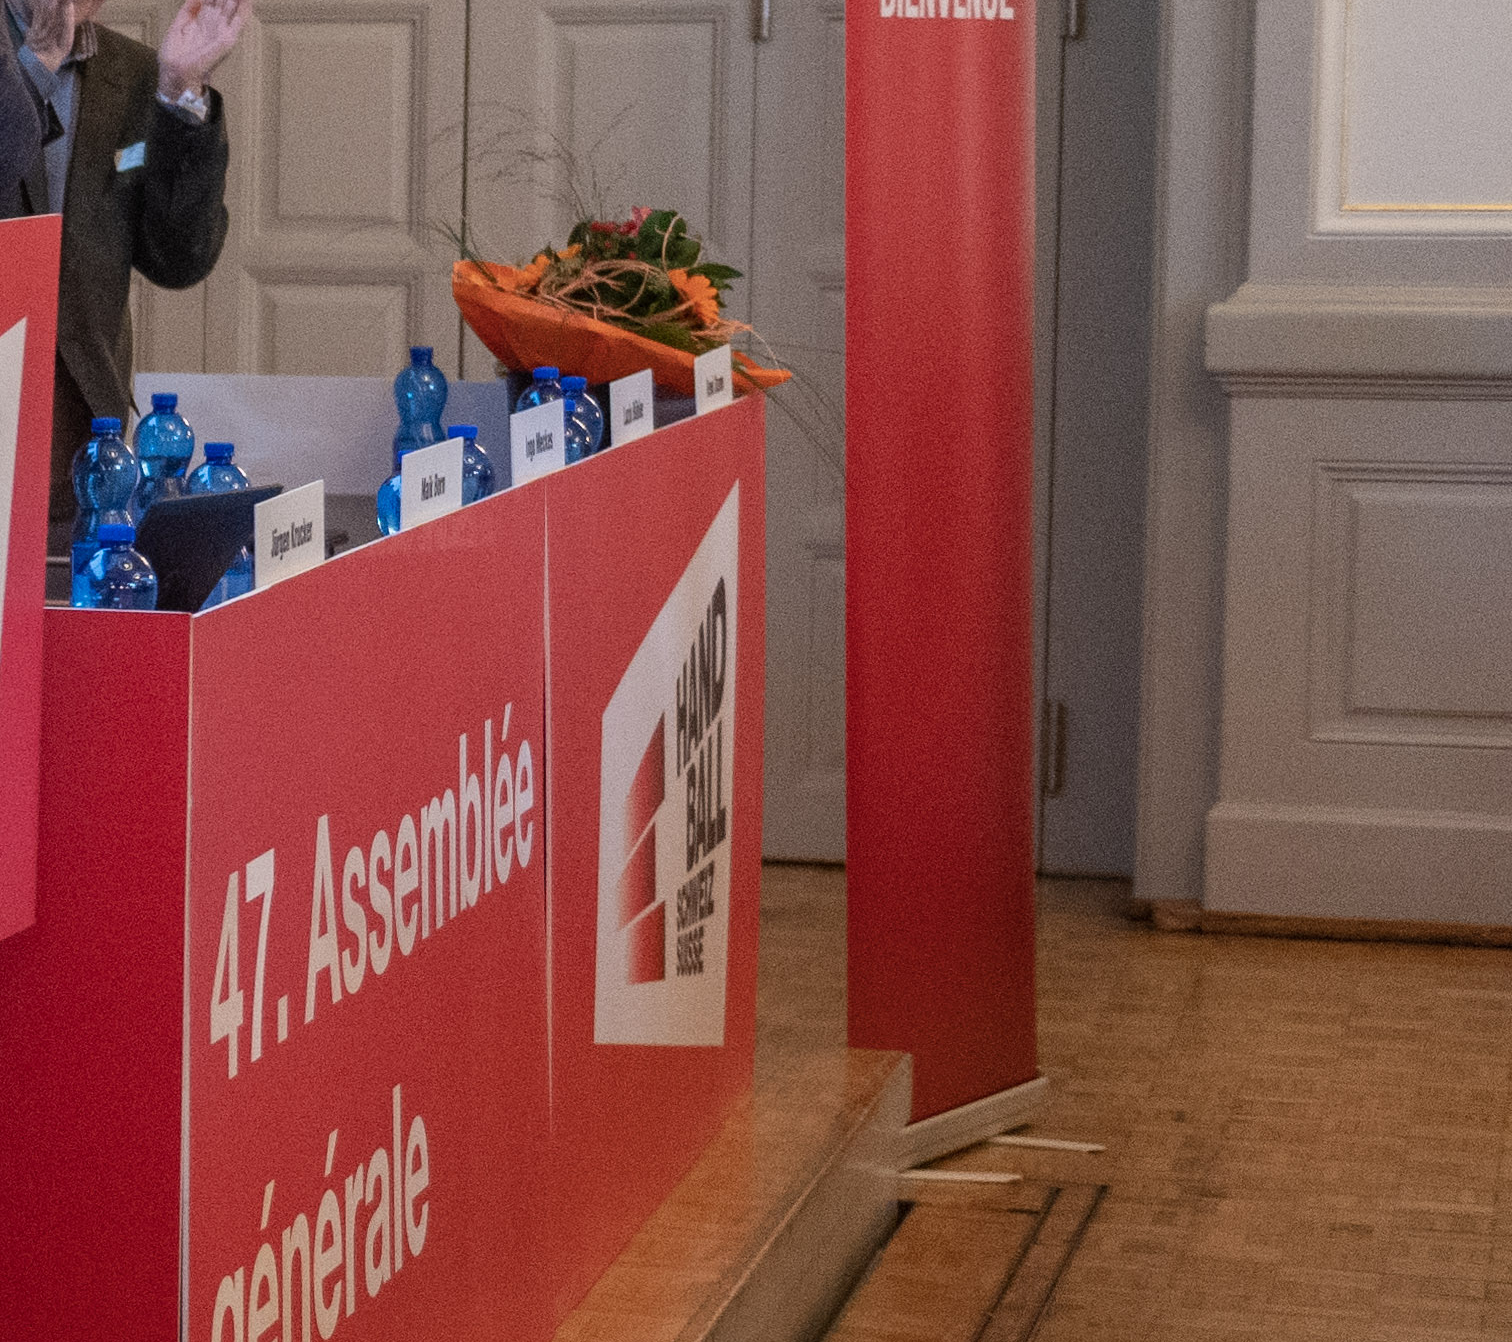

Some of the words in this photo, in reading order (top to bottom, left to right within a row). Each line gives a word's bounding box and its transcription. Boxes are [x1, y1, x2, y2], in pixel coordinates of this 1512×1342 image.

[676, 576, 726, 777] HAND
[210, 849, 289, 1079] 47.
[303, 702, 534, 1025] Assemblée
[686, 720, 726, 872] BALL
